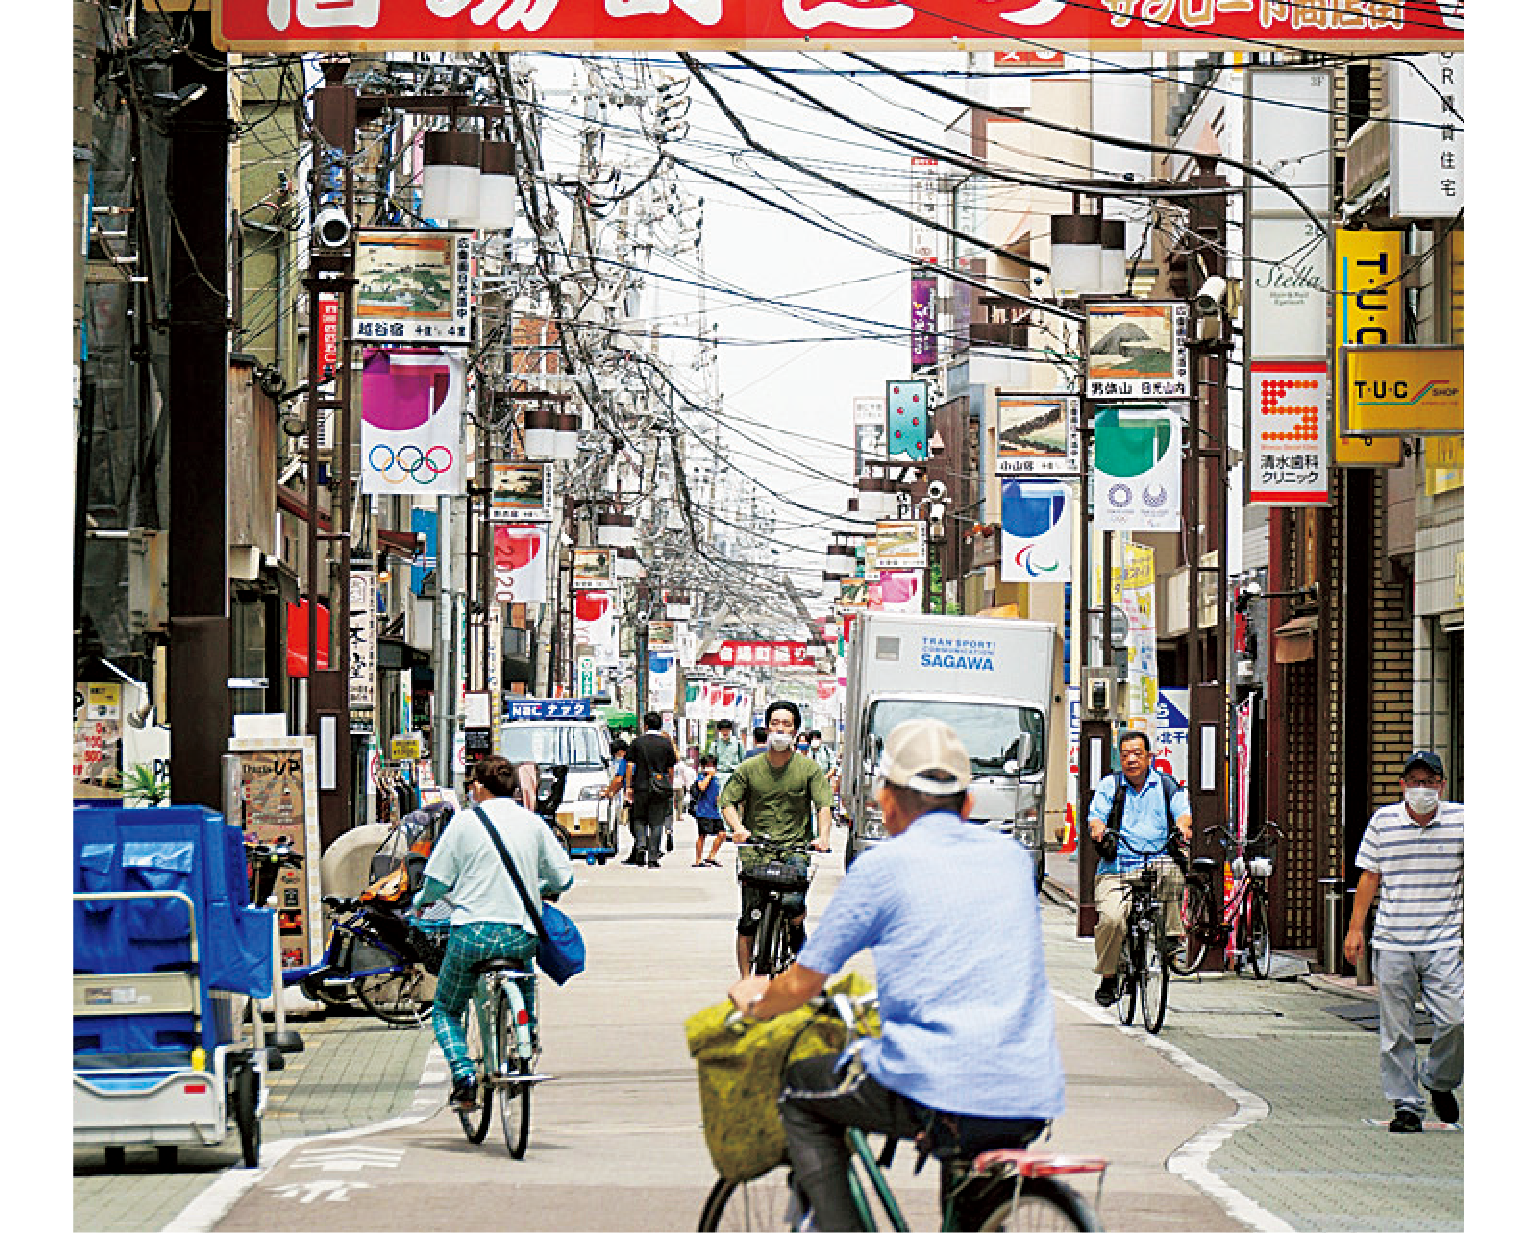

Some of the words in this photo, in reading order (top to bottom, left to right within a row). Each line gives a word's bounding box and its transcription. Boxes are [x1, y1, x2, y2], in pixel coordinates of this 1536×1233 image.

[1261, 454, 1319, 469] 清水歯科
[1262, 471, 1319, 484] クリニック
[921, 653, 994, 671] SAGAWA
